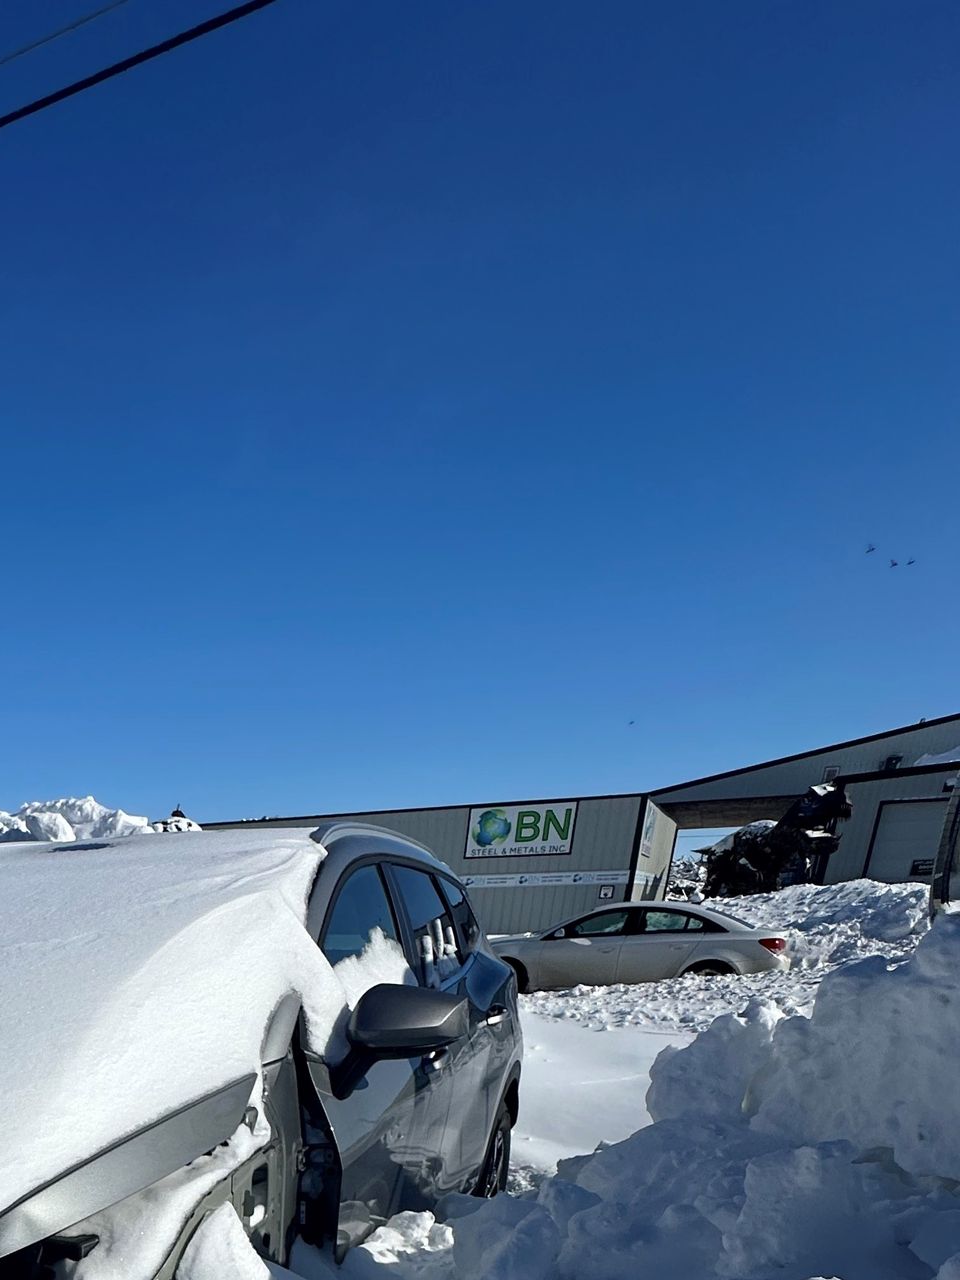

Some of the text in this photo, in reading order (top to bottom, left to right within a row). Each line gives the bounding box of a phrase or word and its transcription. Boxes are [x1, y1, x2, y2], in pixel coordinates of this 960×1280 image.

[515, 808, 572, 843] BN
[471, 848, 498, 856] STEEL
[509, 846, 546, 854] METALS
